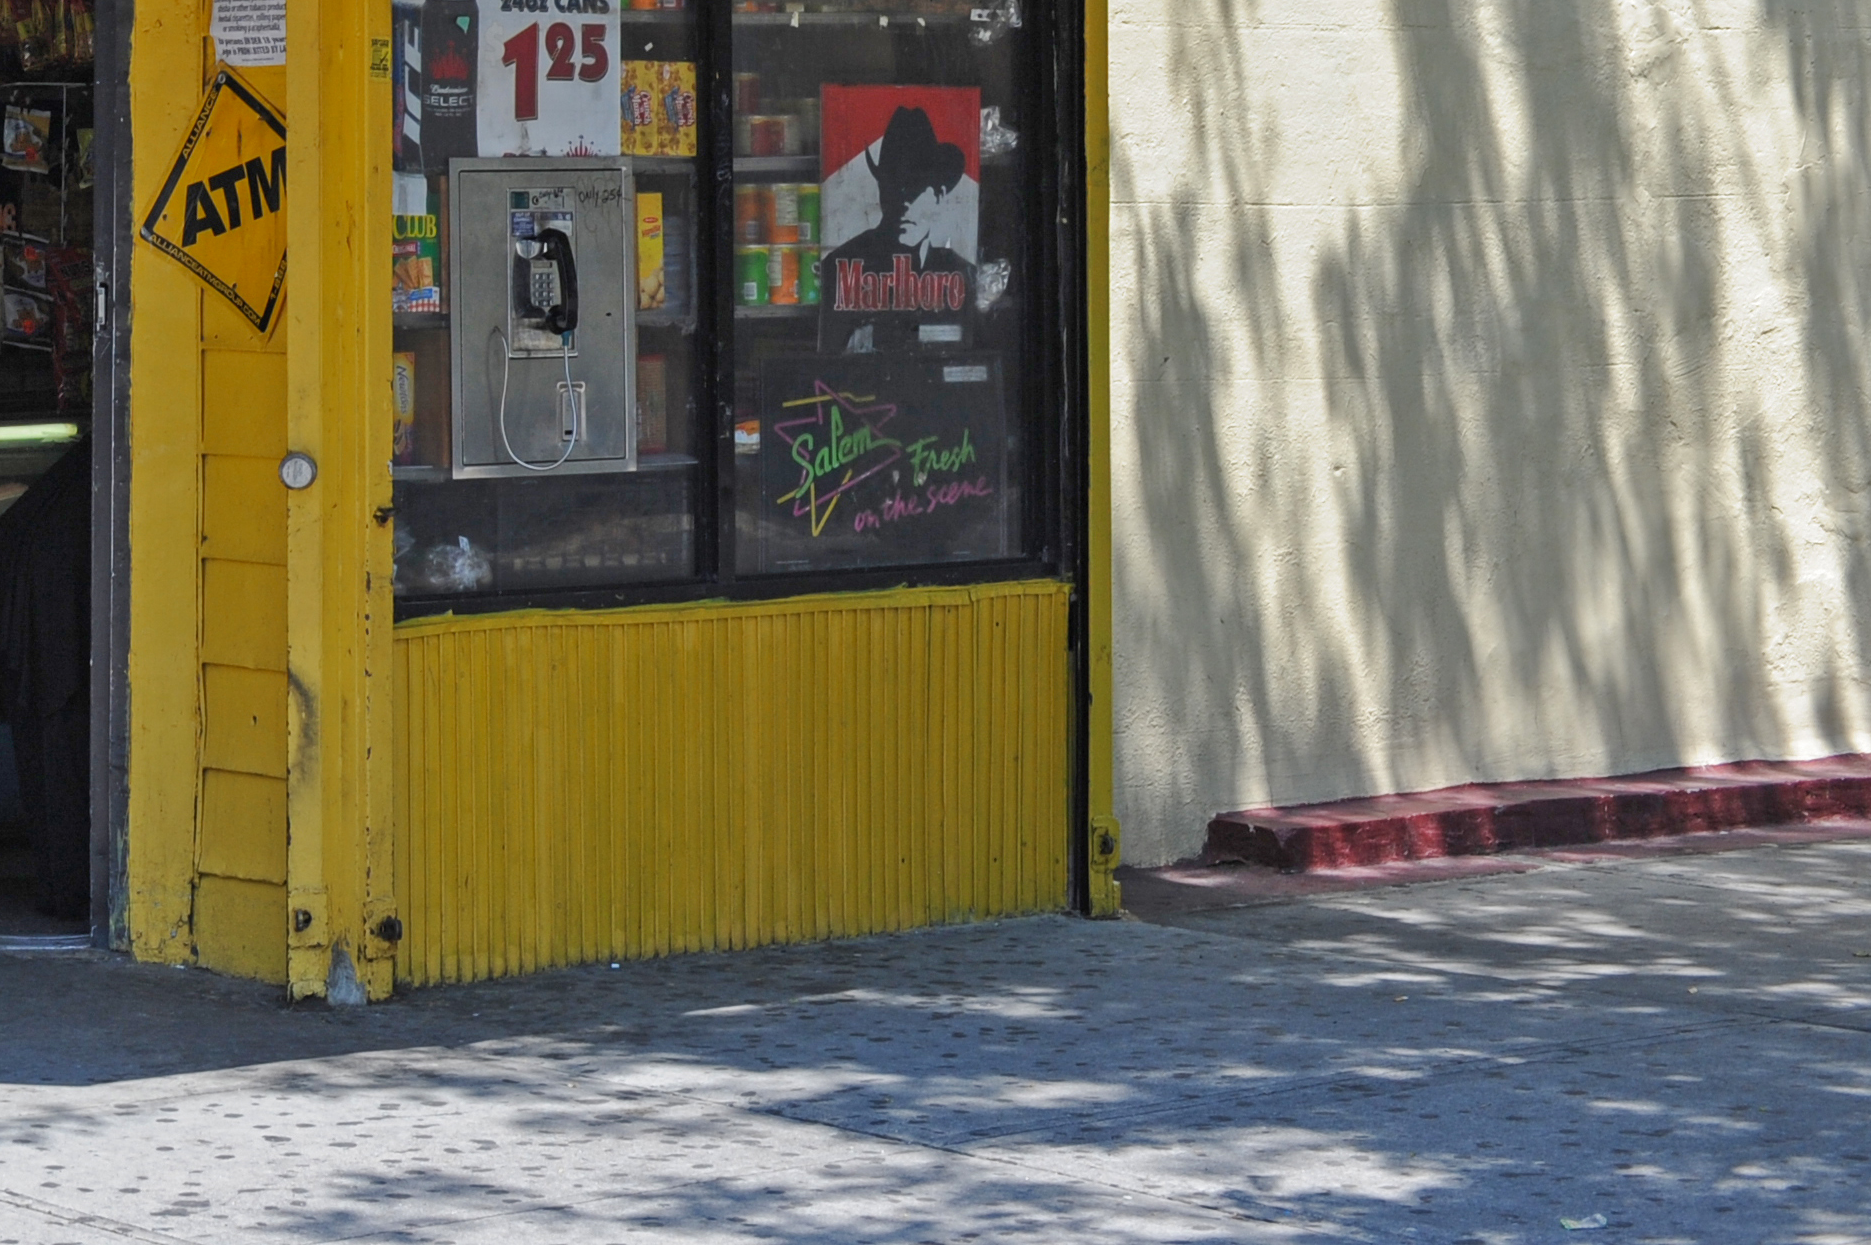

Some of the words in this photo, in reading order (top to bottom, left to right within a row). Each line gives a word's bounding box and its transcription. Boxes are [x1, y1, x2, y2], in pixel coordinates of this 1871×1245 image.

[424, 95, 473, 106] SELECT
[430, 84, 468, 94] Budweiser
[181, 89, 219, 159] ALLIANCE
[182, 145, 287, 248] ATM
[392, 215, 437, 240] CLUB
[834, 255, 965, 312] Marlboro
[792, 406, 901, 498] Salem
[906, 428, 975, 486] Fresh
[854, 511, 880, 532] on
[882, 492, 923, 521] the
[926, 477, 993, 513] scene
